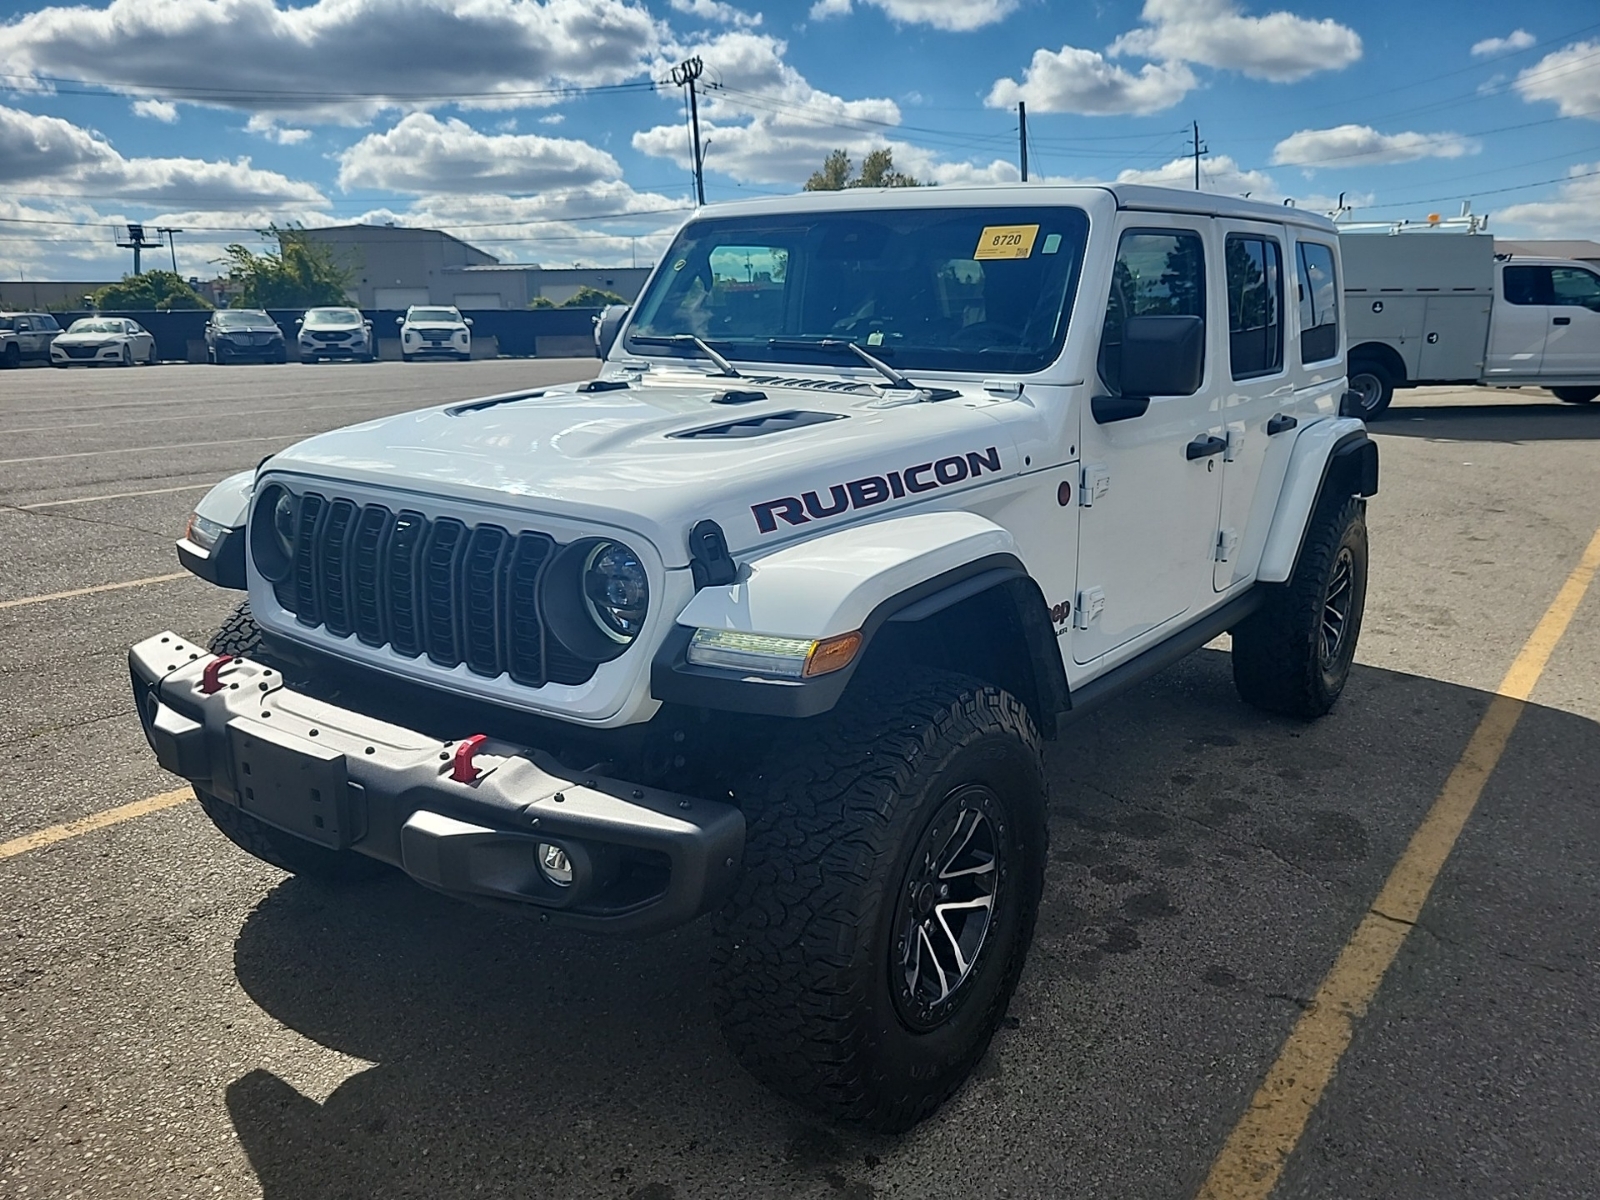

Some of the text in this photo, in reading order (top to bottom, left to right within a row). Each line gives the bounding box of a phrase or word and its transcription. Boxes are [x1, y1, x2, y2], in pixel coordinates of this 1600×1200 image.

[992, 234, 1022, 246] 8720
[750, 446, 1002, 534] RUBICON
[1049, 600, 1071, 625] ep
